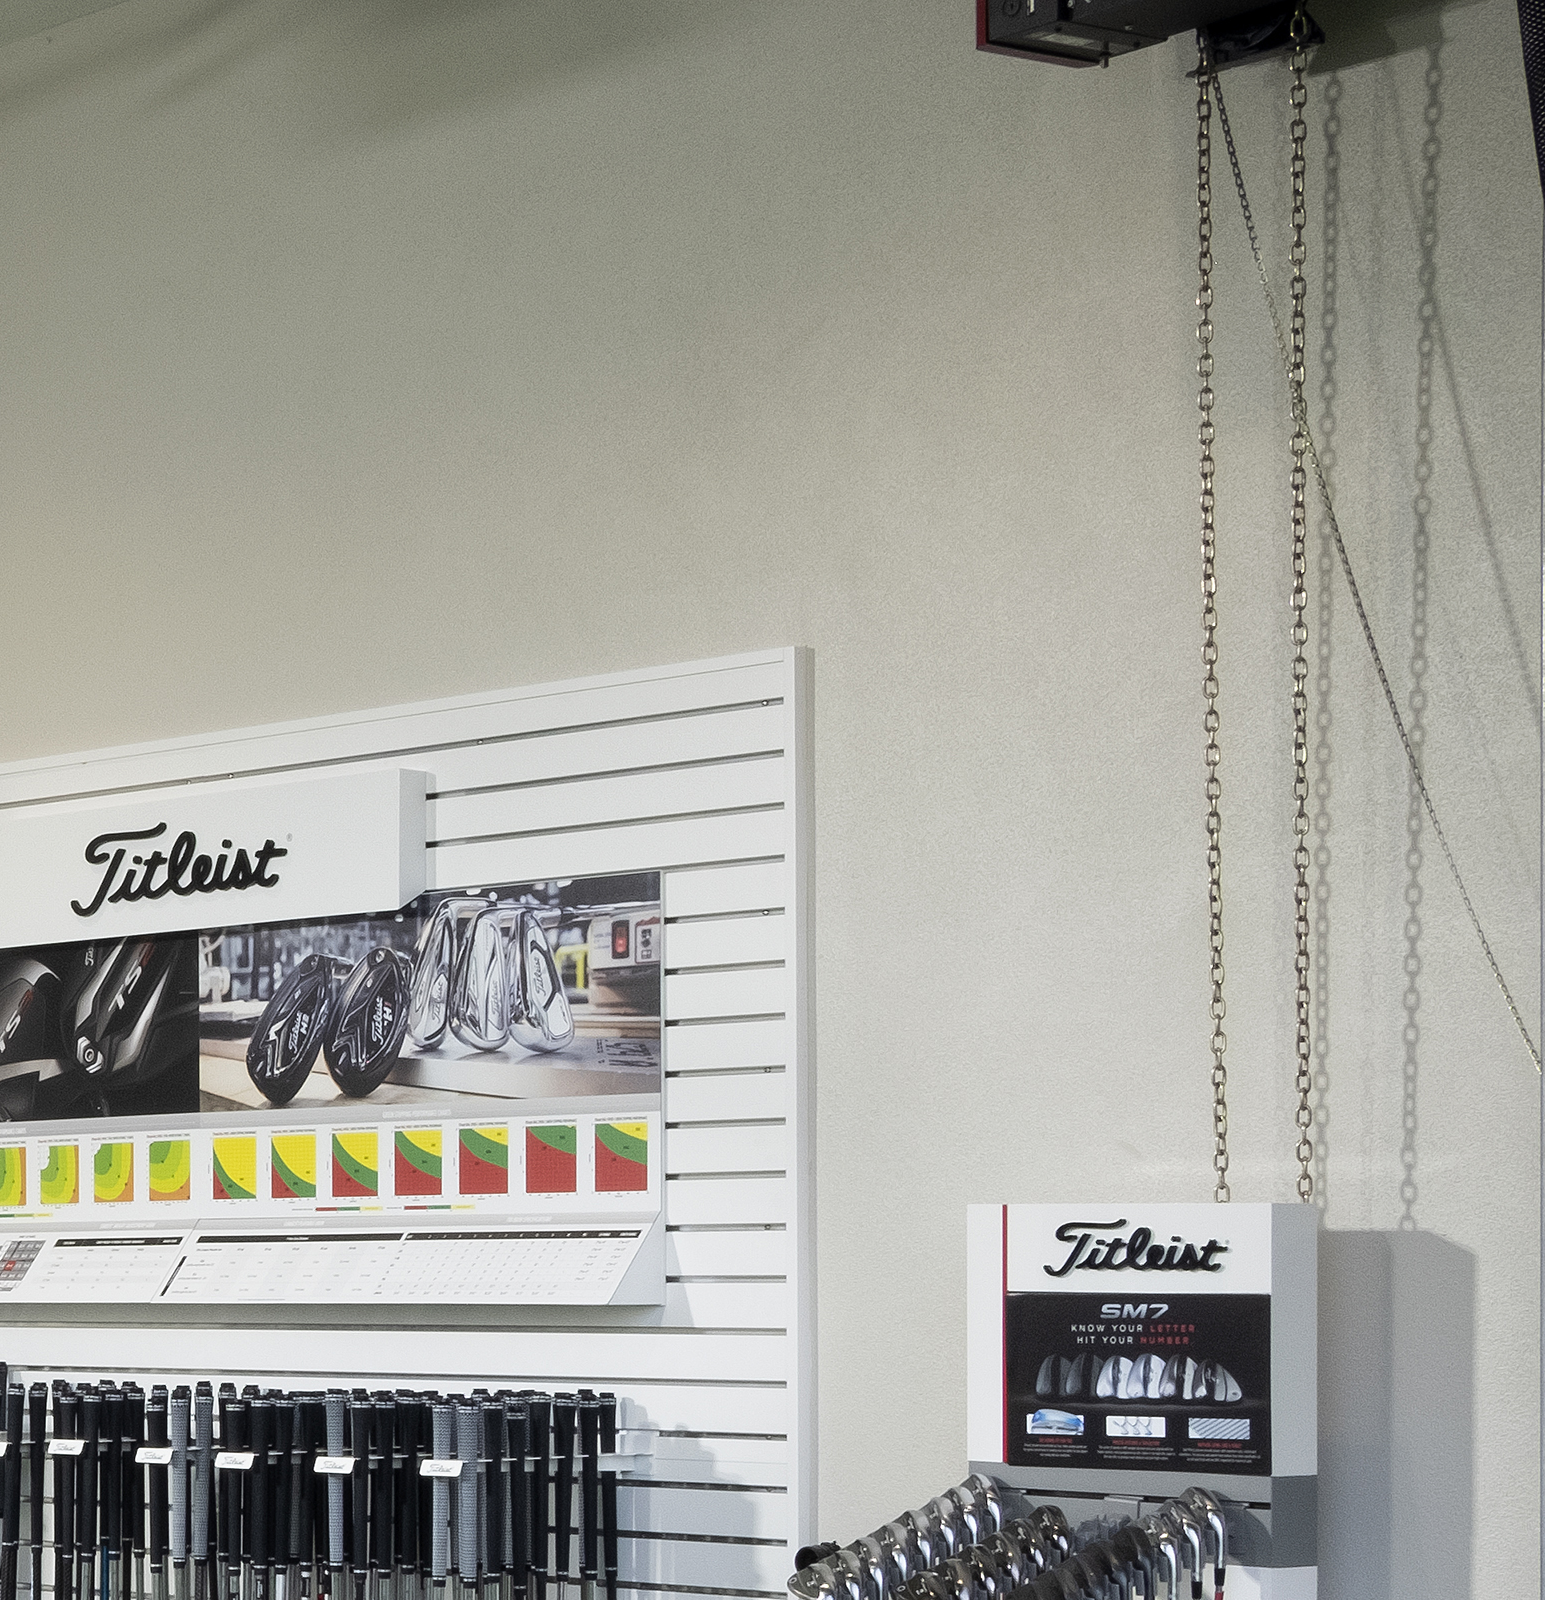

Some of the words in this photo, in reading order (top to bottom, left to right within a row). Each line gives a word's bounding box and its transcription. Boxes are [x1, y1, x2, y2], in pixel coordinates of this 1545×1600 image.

[70, 822, 289, 917] Titleist
[1042, 1217, 1229, 1278] Titleist
[1099, 1303, 1169, 1320] SM7
[1071, 1324, 1106, 1333] KNOW
[1111, 1324, 1143, 1333] YOUR
[1076, 1336, 1096, 1345] HIT
[1102, 1336, 1134, 1345] YOUR
